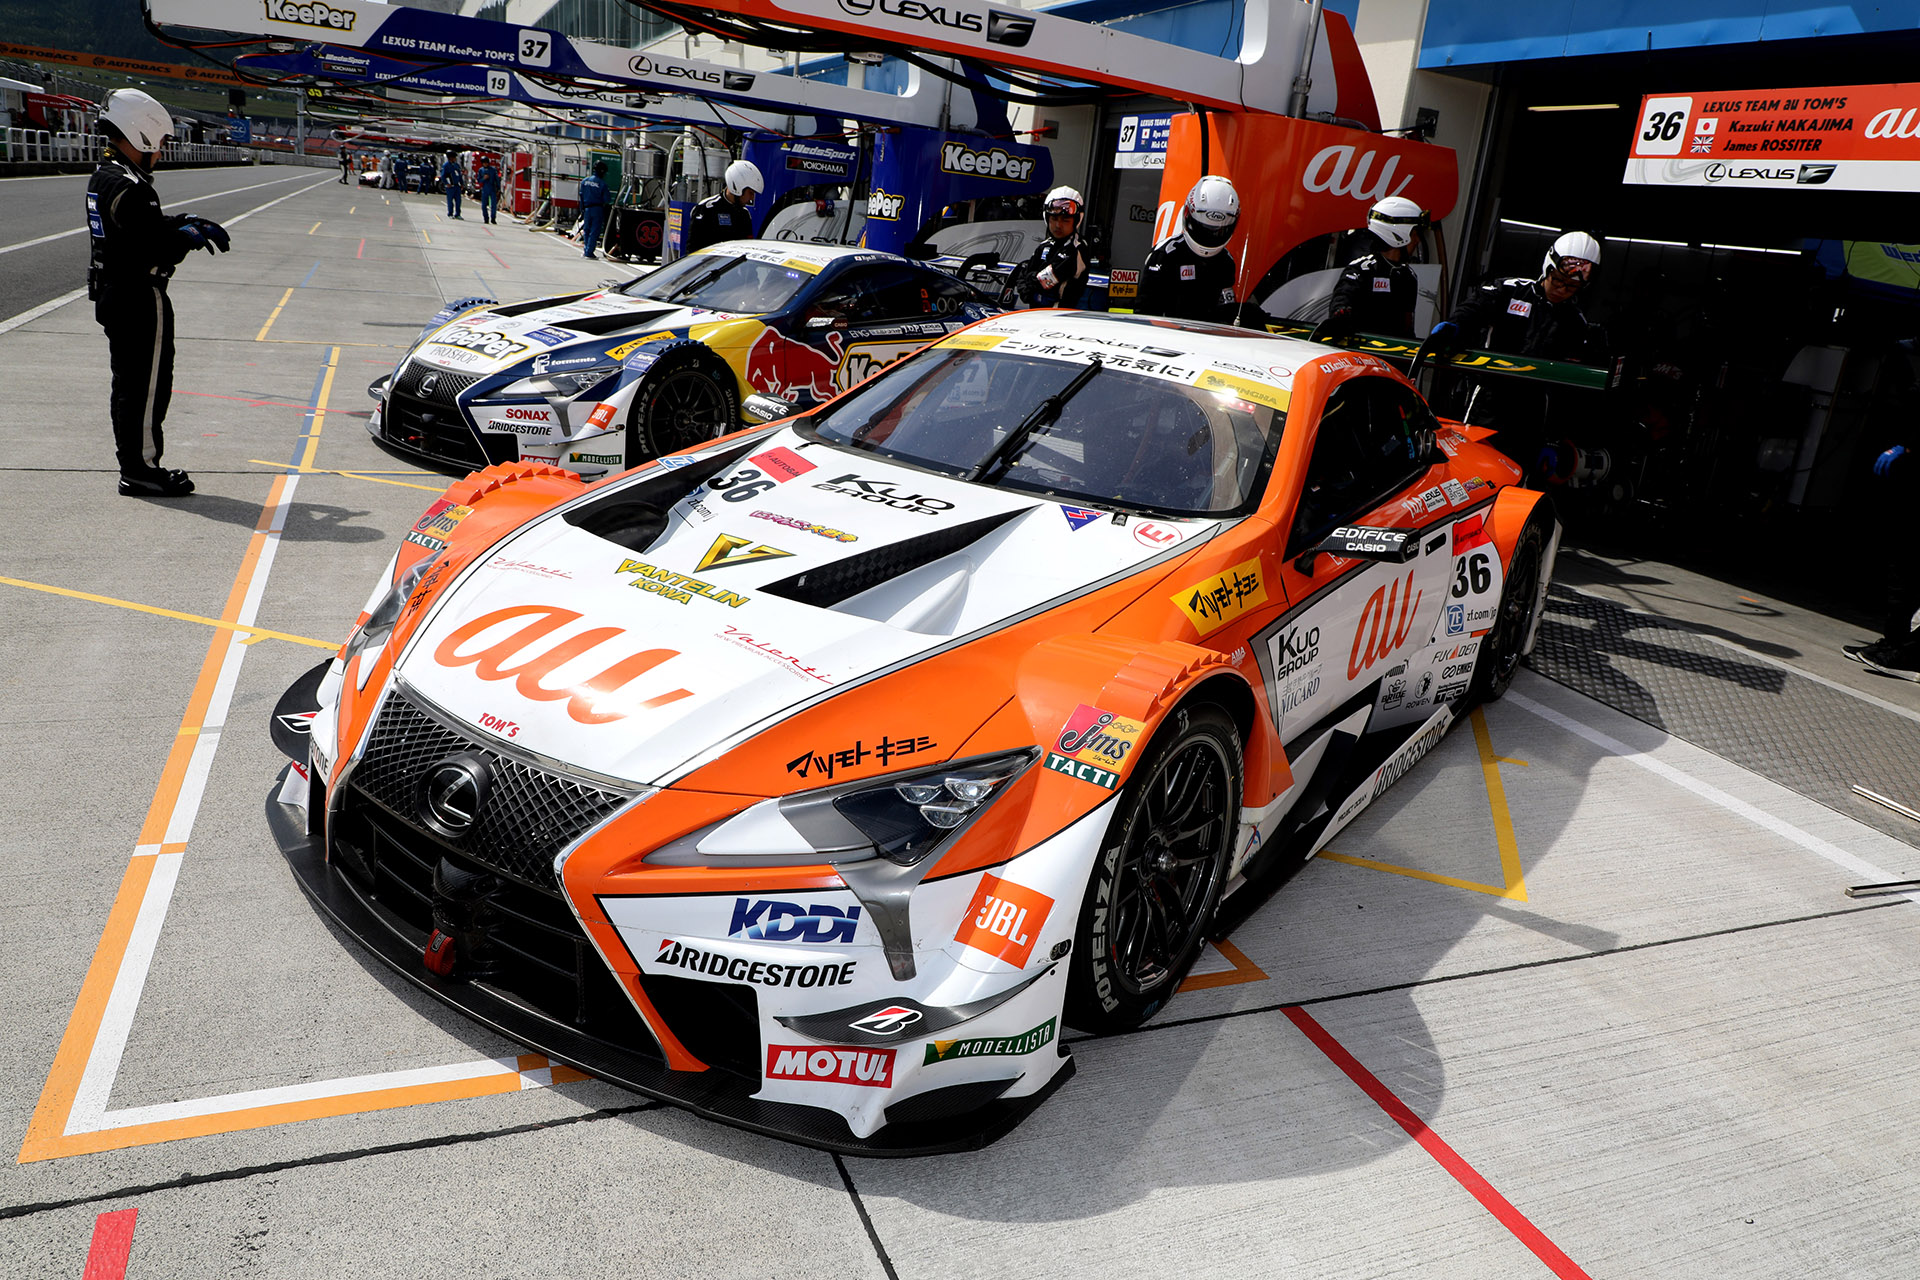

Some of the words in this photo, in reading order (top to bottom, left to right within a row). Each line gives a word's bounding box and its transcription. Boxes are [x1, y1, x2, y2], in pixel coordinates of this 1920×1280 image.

[266, 0, 354, 30] KeePer
[879, 0, 982, 33] LEXUS
[9, 45, 78, 62] AUTOBACS
[382, 35, 416, 48] LEXUS
[418, 40, 446, 52] TEAM
[448, 45, 482, 57] KeePer
[484, 49, 515, 62] TOM'S
[521, 39, 549, 59] 37
[106, 59, 171, 74] AUTOBACS
[654, 63, 721, 83] LEXUS
[455, 82, 485, 92] BANDOH
[490, 77, 506, 90] 19
[1702, 100, 1742, 113] LEXUS
[1745, 99, 1780, 112] TEAM
[1782, 98, 1800, 111] au
[1803, 97, 1848, 110] TOM'S
[1120, 125, 1136, 143] 37
[1643, 111, 1685, 141] 36
[1728, 120, 1775, 133] Kazuki
[1777, 117, 1854, 132] NAKAJIMA
[790, 143, 856, 160] WedsSport
[1723, 139, 1758, 152] James
[1760, 138, 1823, 152] ROSSITER
[802, 160, 845, 174] YOKOHAMA
[943, 143, 1034, 181] KeePer
[1302, 144, 1415, 201] au
[1727, 167, 1796, 180] LEXUS
[1208, 211, 1224, 220] Arai
[639, 225, 661, 244] 35
[1111, 270, 1139, 282] SONAX
[1181, 268, 1195, 277] au
[1374, 280, 1389, 289] au
[1508, 301, 1529, 314] au
[433, 327, 528, 360] KeePer
[1066, 334, 1138, 350] LEXUS
[505, 408, 550, 421] SONAX
[592, 408, 608, 423] JBL
[637, 383, 656, 454] POTENZA
[748, 405, 773, 422] CASIO
[487, 420, 553, 436] BRIDGESTONE
[582, 454, 620, 465] MODELLISTA
[706, 469, 777, 503] 36
[1422, 488, 1442, 502] LEXUS
[811, 483, 938, 516] GROUP
[407, 531, 444, 551] TACTI
[1137, 523, 1176, 544] E
[1331, 527, 1408, 543] EDIFICE
[1345, 542, 1387, 552] CASIO
[614, 558, 751, 609] VANTELIN
[1451, 553, 1492, 599] 36
[629, 577, 692, 606] KOWA
[1346, 568, 1423, 681] au
[1450, 611, 1462, 627] ZF
[433, 604, 696, 725] au
[1277, 646, 1319, 681] GROUP
[1381, 690, 1407, 704] BRIDE
[1436, 686, 1465, 702] TRD
[1405, 698, 1432, 710] ROWEN
[478, 712, 520, 738] TOM'S
[786, 735, 937, 780] マツモトキヨシ
[1050, 754, 1116, 788] TACTI
[728, 898, 862, 944] KDDI
[975, 895, 1029, 947] JBL
[1091, 845, 1122, 1013] POTENZA
[655, 939, 857, 988] BRIDGESTONE
[958, 1025, 1051, 1056] MODELLISTA
[772, 1050, 889, 1084] MOTUL
